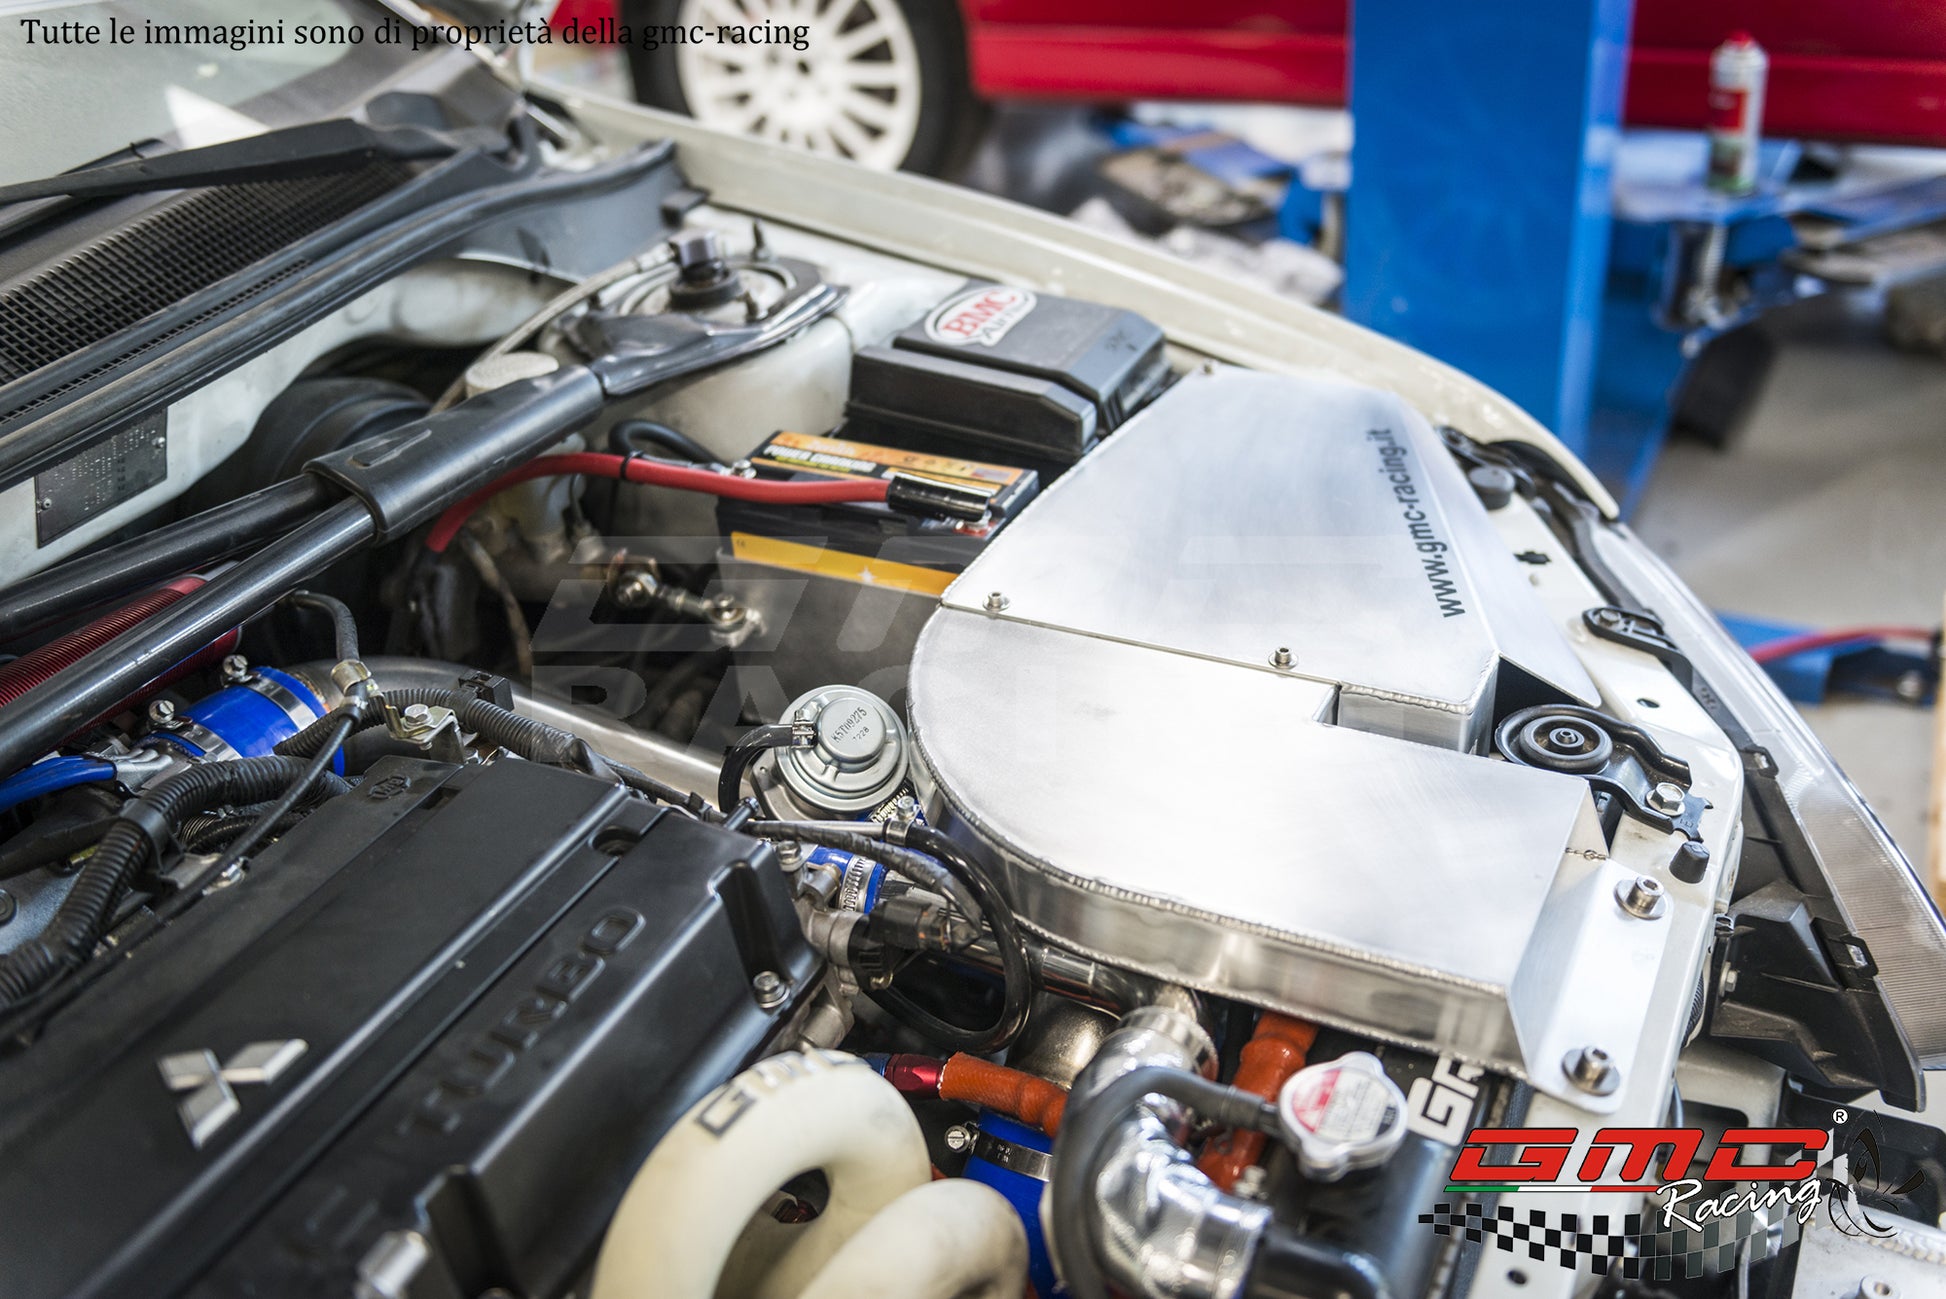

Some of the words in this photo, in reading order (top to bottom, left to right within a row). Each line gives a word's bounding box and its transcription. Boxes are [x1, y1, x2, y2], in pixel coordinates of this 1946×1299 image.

[943, 290, 1017, 336] BMC
[1366, 427, 1466, 618] www.gmc-racing.it
[398, 905, 648, 1134] TURBO
